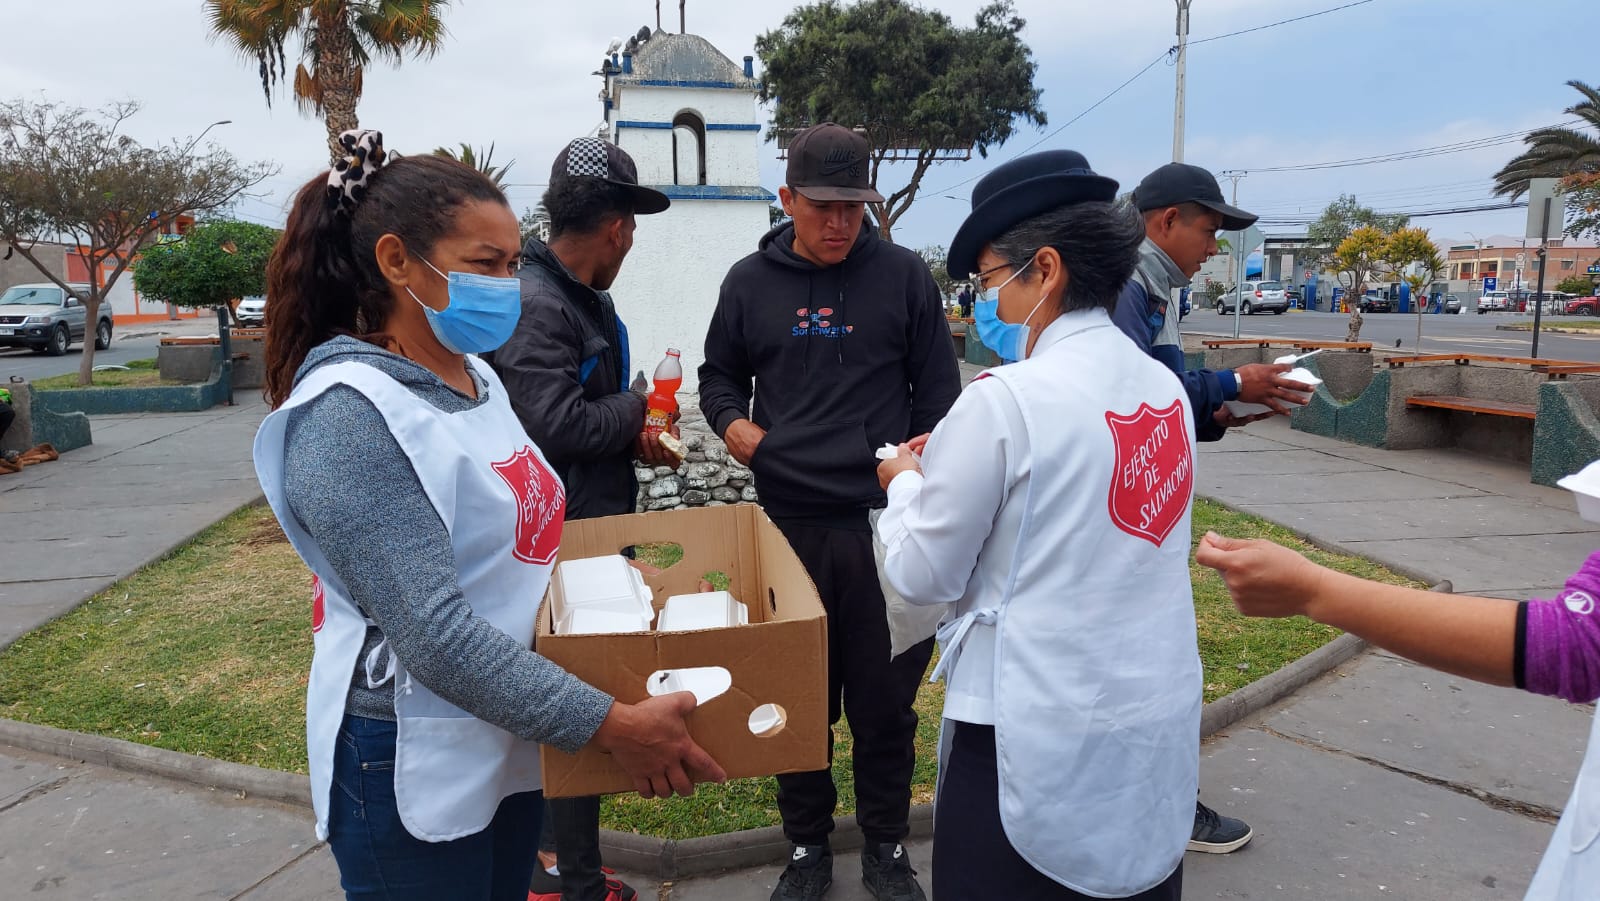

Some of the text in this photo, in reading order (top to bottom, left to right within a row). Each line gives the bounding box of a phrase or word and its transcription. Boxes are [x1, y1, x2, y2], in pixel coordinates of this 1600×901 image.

[824, 147, 858, 162] NIKE
[1124, 419, 1169, 491] EJÉRCITO
[1144, 463, 1161, 494] DE
[1140, 450, 1190, 530] SALVACIÓN
